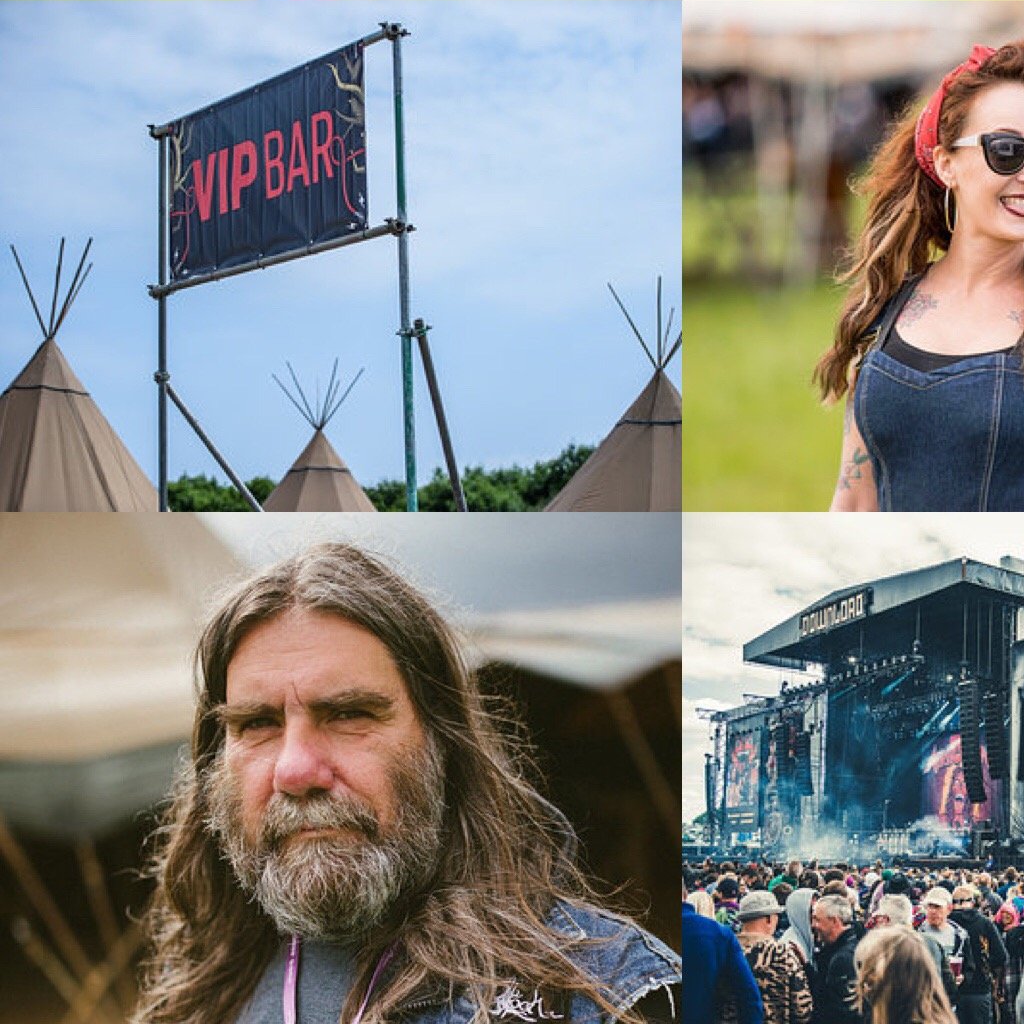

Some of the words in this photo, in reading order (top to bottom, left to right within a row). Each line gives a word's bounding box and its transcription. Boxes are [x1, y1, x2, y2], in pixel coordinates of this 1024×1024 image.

[192, 139, 258, 222] VIP
[264, 109, 335, 201] BAR
[802, 593, 863, 636] DOWNLOAD
